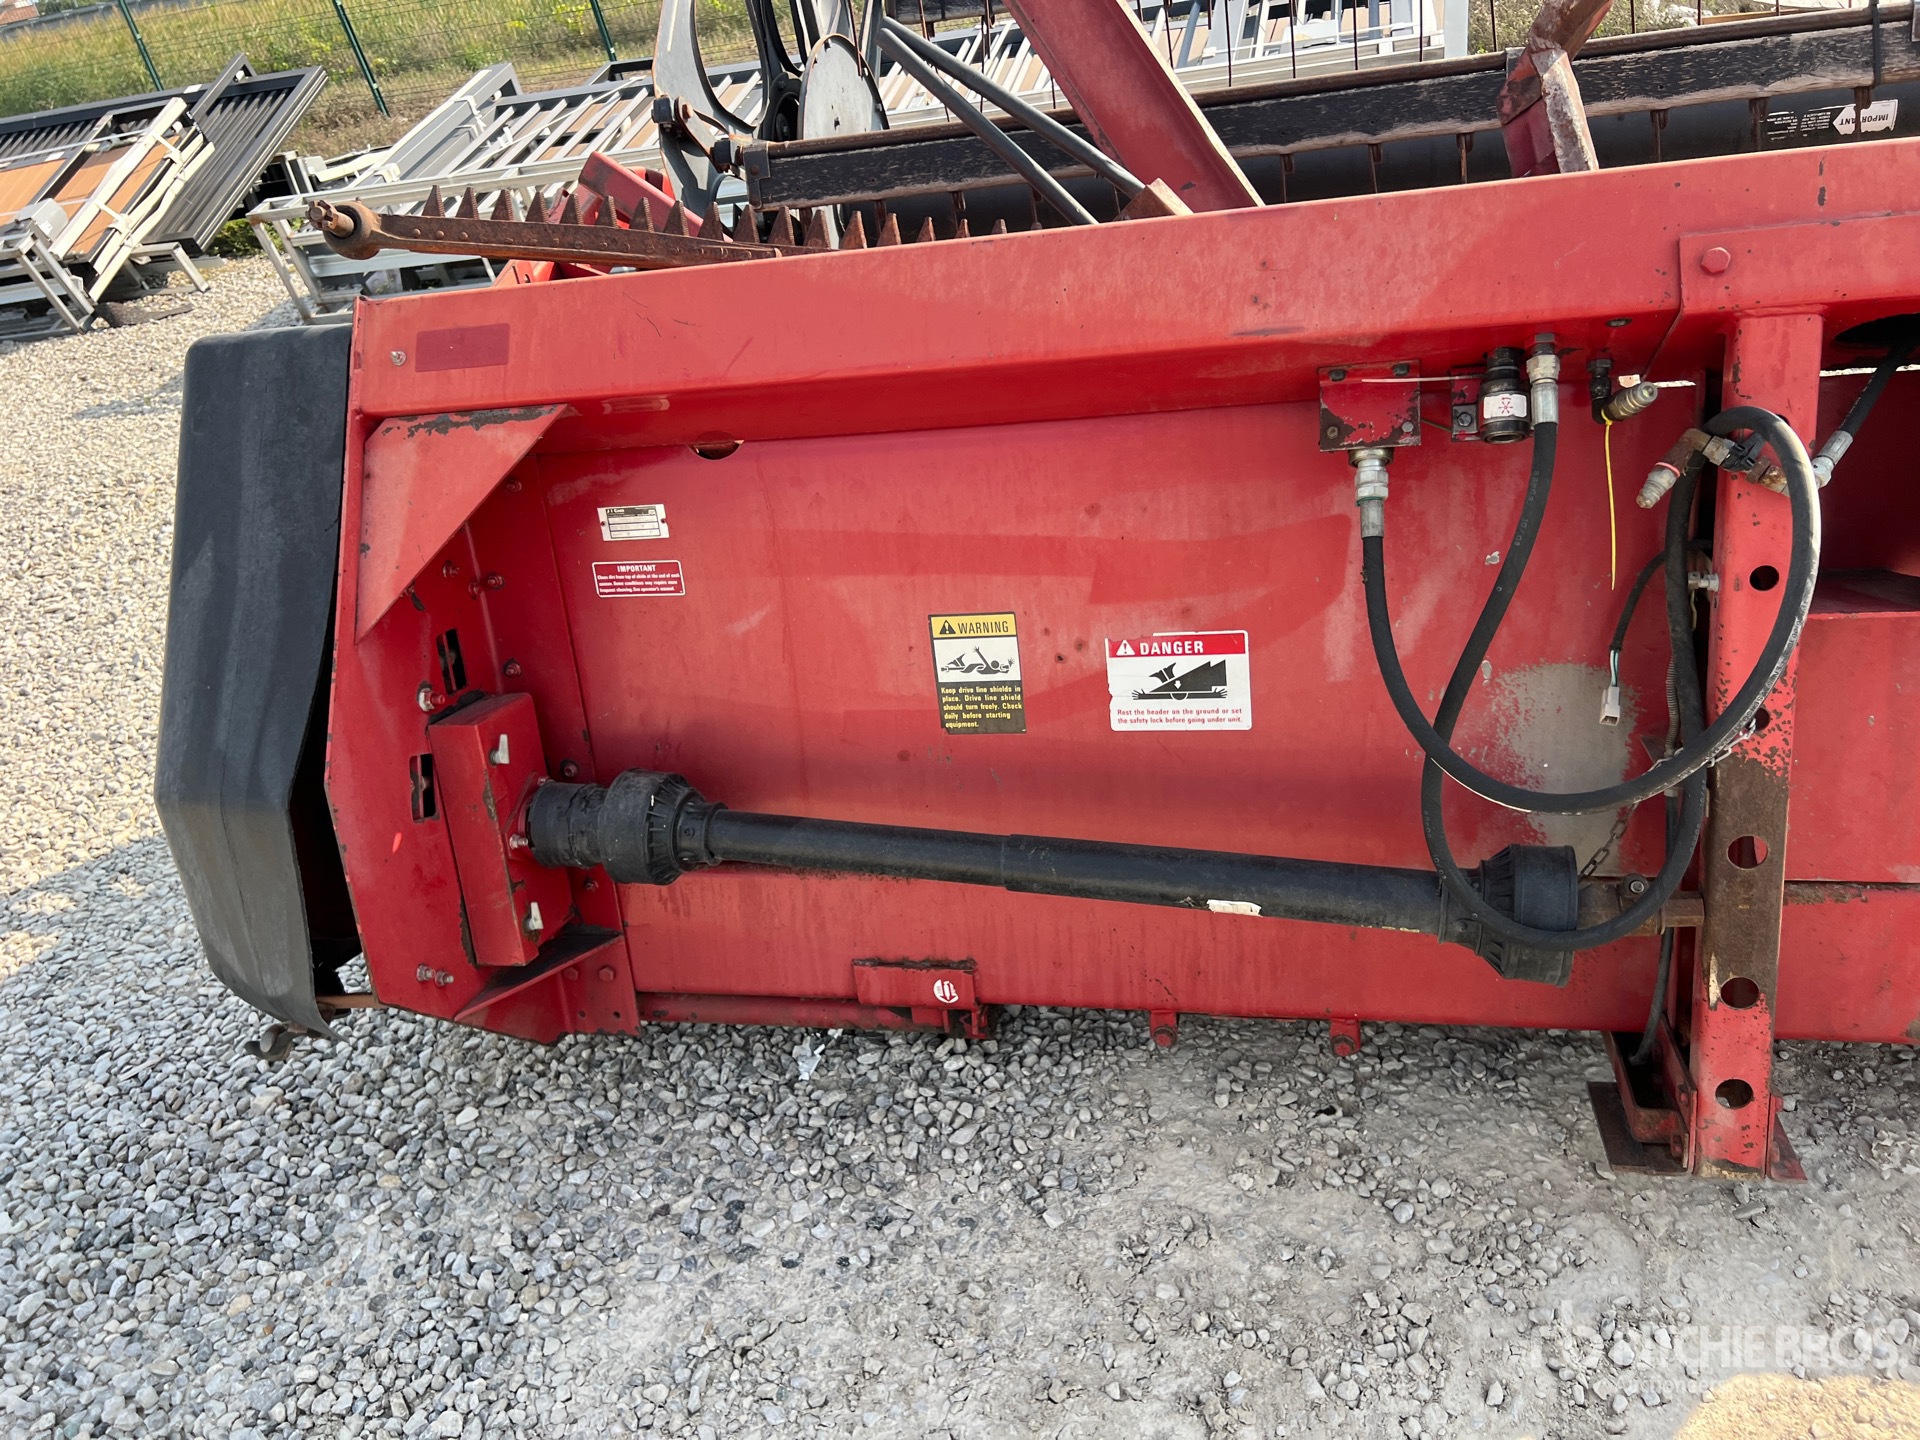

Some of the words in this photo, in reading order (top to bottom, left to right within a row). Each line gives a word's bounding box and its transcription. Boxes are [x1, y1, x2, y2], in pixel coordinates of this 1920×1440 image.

[1839, 113, 1889, 126] IMPORANT
[617, 564, 656, 572] IMPORTANT
[958, 620, 1009, 634] WARNING
[1140, 640, 1204, 655] DANGER
[1195, 708, 1219, 716] ground
[945, 721, 980, 729] equipment.
